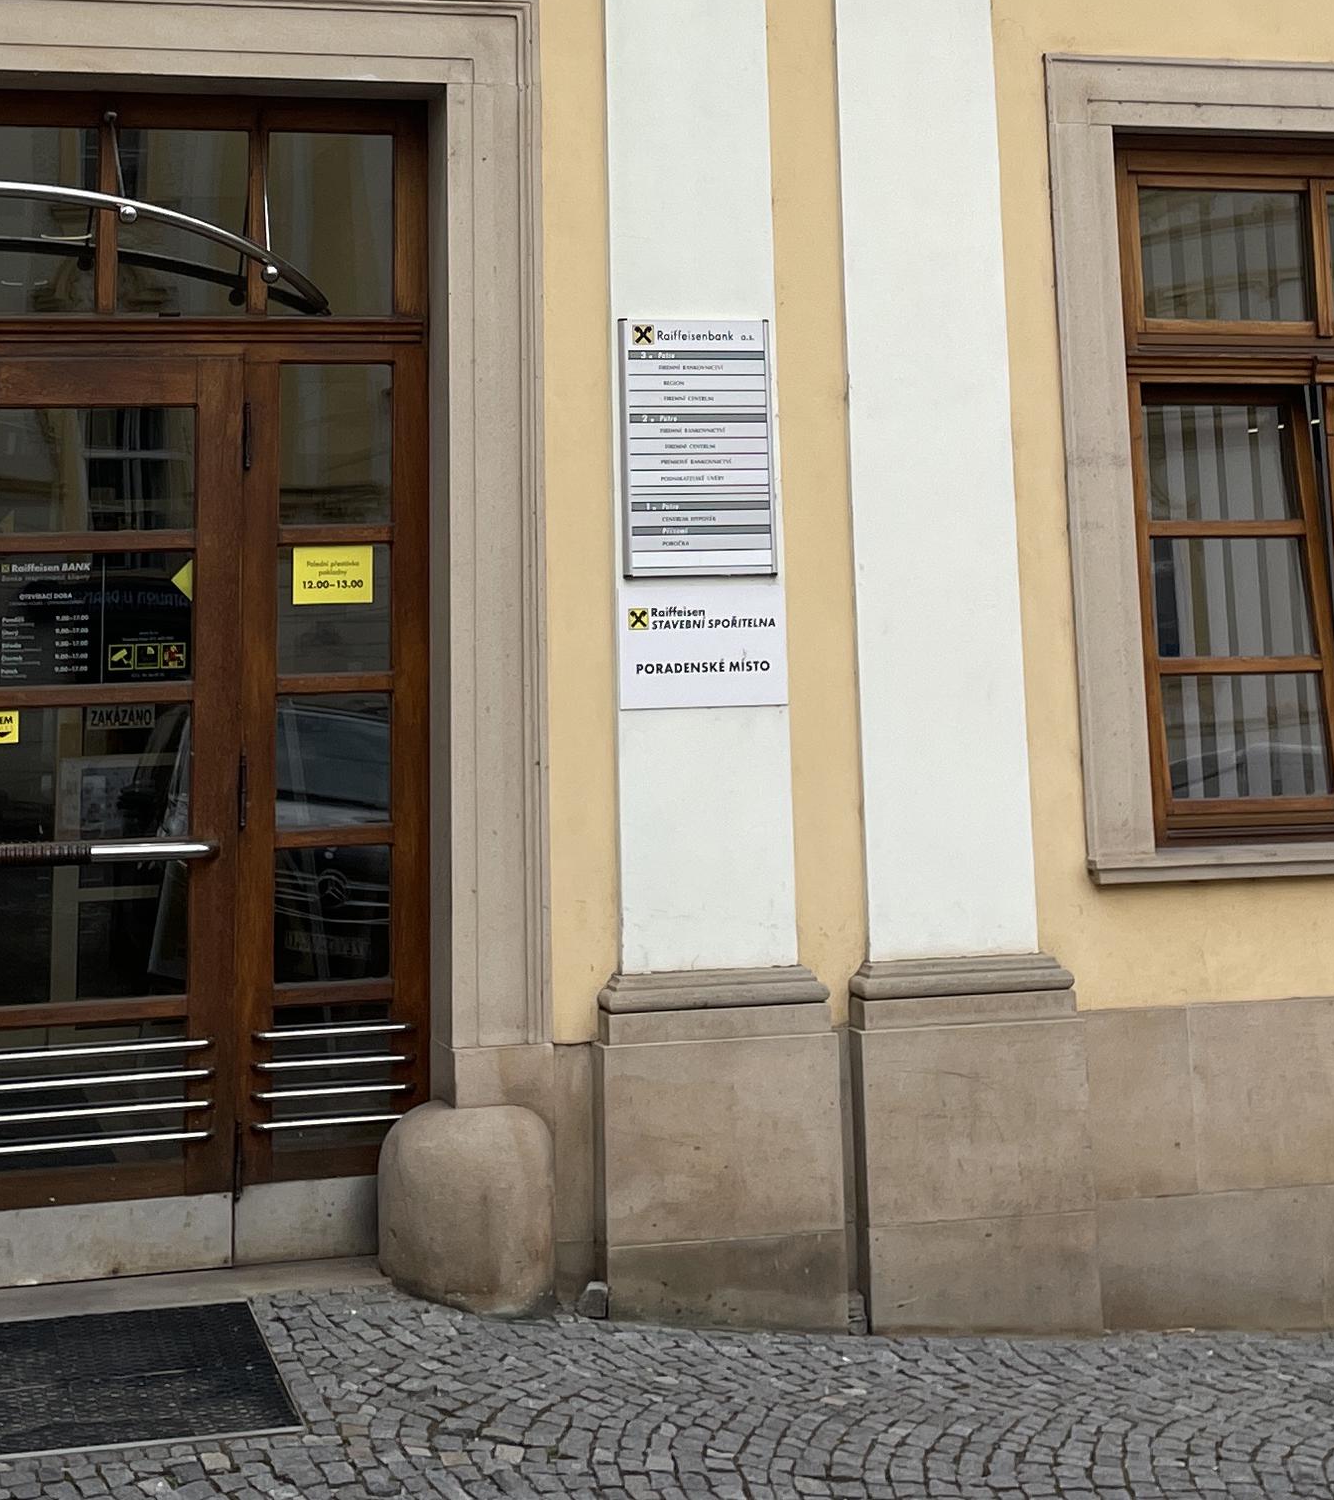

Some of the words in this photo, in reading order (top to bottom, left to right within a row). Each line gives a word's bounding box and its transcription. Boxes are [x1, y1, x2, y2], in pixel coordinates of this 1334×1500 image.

[657, 330, 733, 341] Raiffeisenbank
[11, 563, 60, 573] Raiffeisen
[61, 562, 92, 572] BANK
[651, 606, 706, 617] Raiffeisen
[651, 617, 706, 630] STAVEBNÍ
[707, 616, 776, 629] SPOŘITELNA
[636, 658, 725, 675] PORADENSKÉ
[729, 658, 771, 673] MÍSTO
[90, 705, 153, 727] ZAKÁZÁNO
